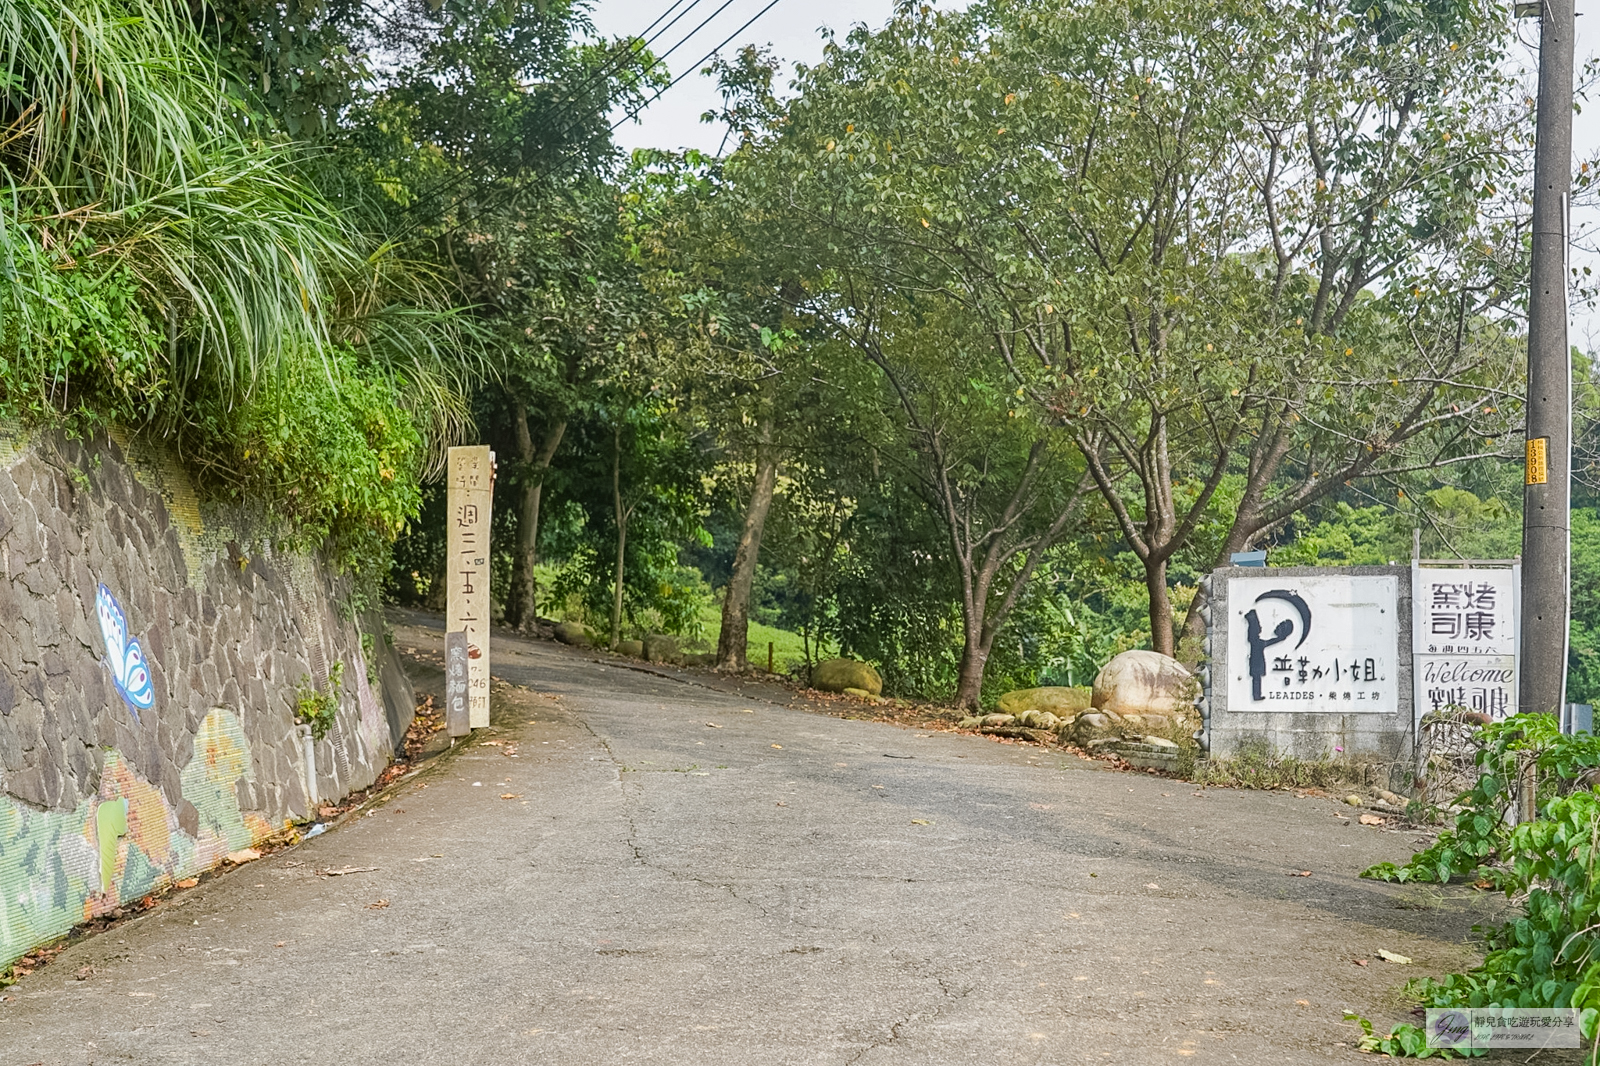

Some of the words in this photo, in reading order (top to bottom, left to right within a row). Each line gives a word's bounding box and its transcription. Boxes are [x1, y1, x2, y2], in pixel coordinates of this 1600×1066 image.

[1530, 440, 1538, 483] 13908
[1430, 611, 1496, 641] 司康
[1423, 661, 1514, 684] Welcome
[1269, 691, 1315, 700] LEAIDES
